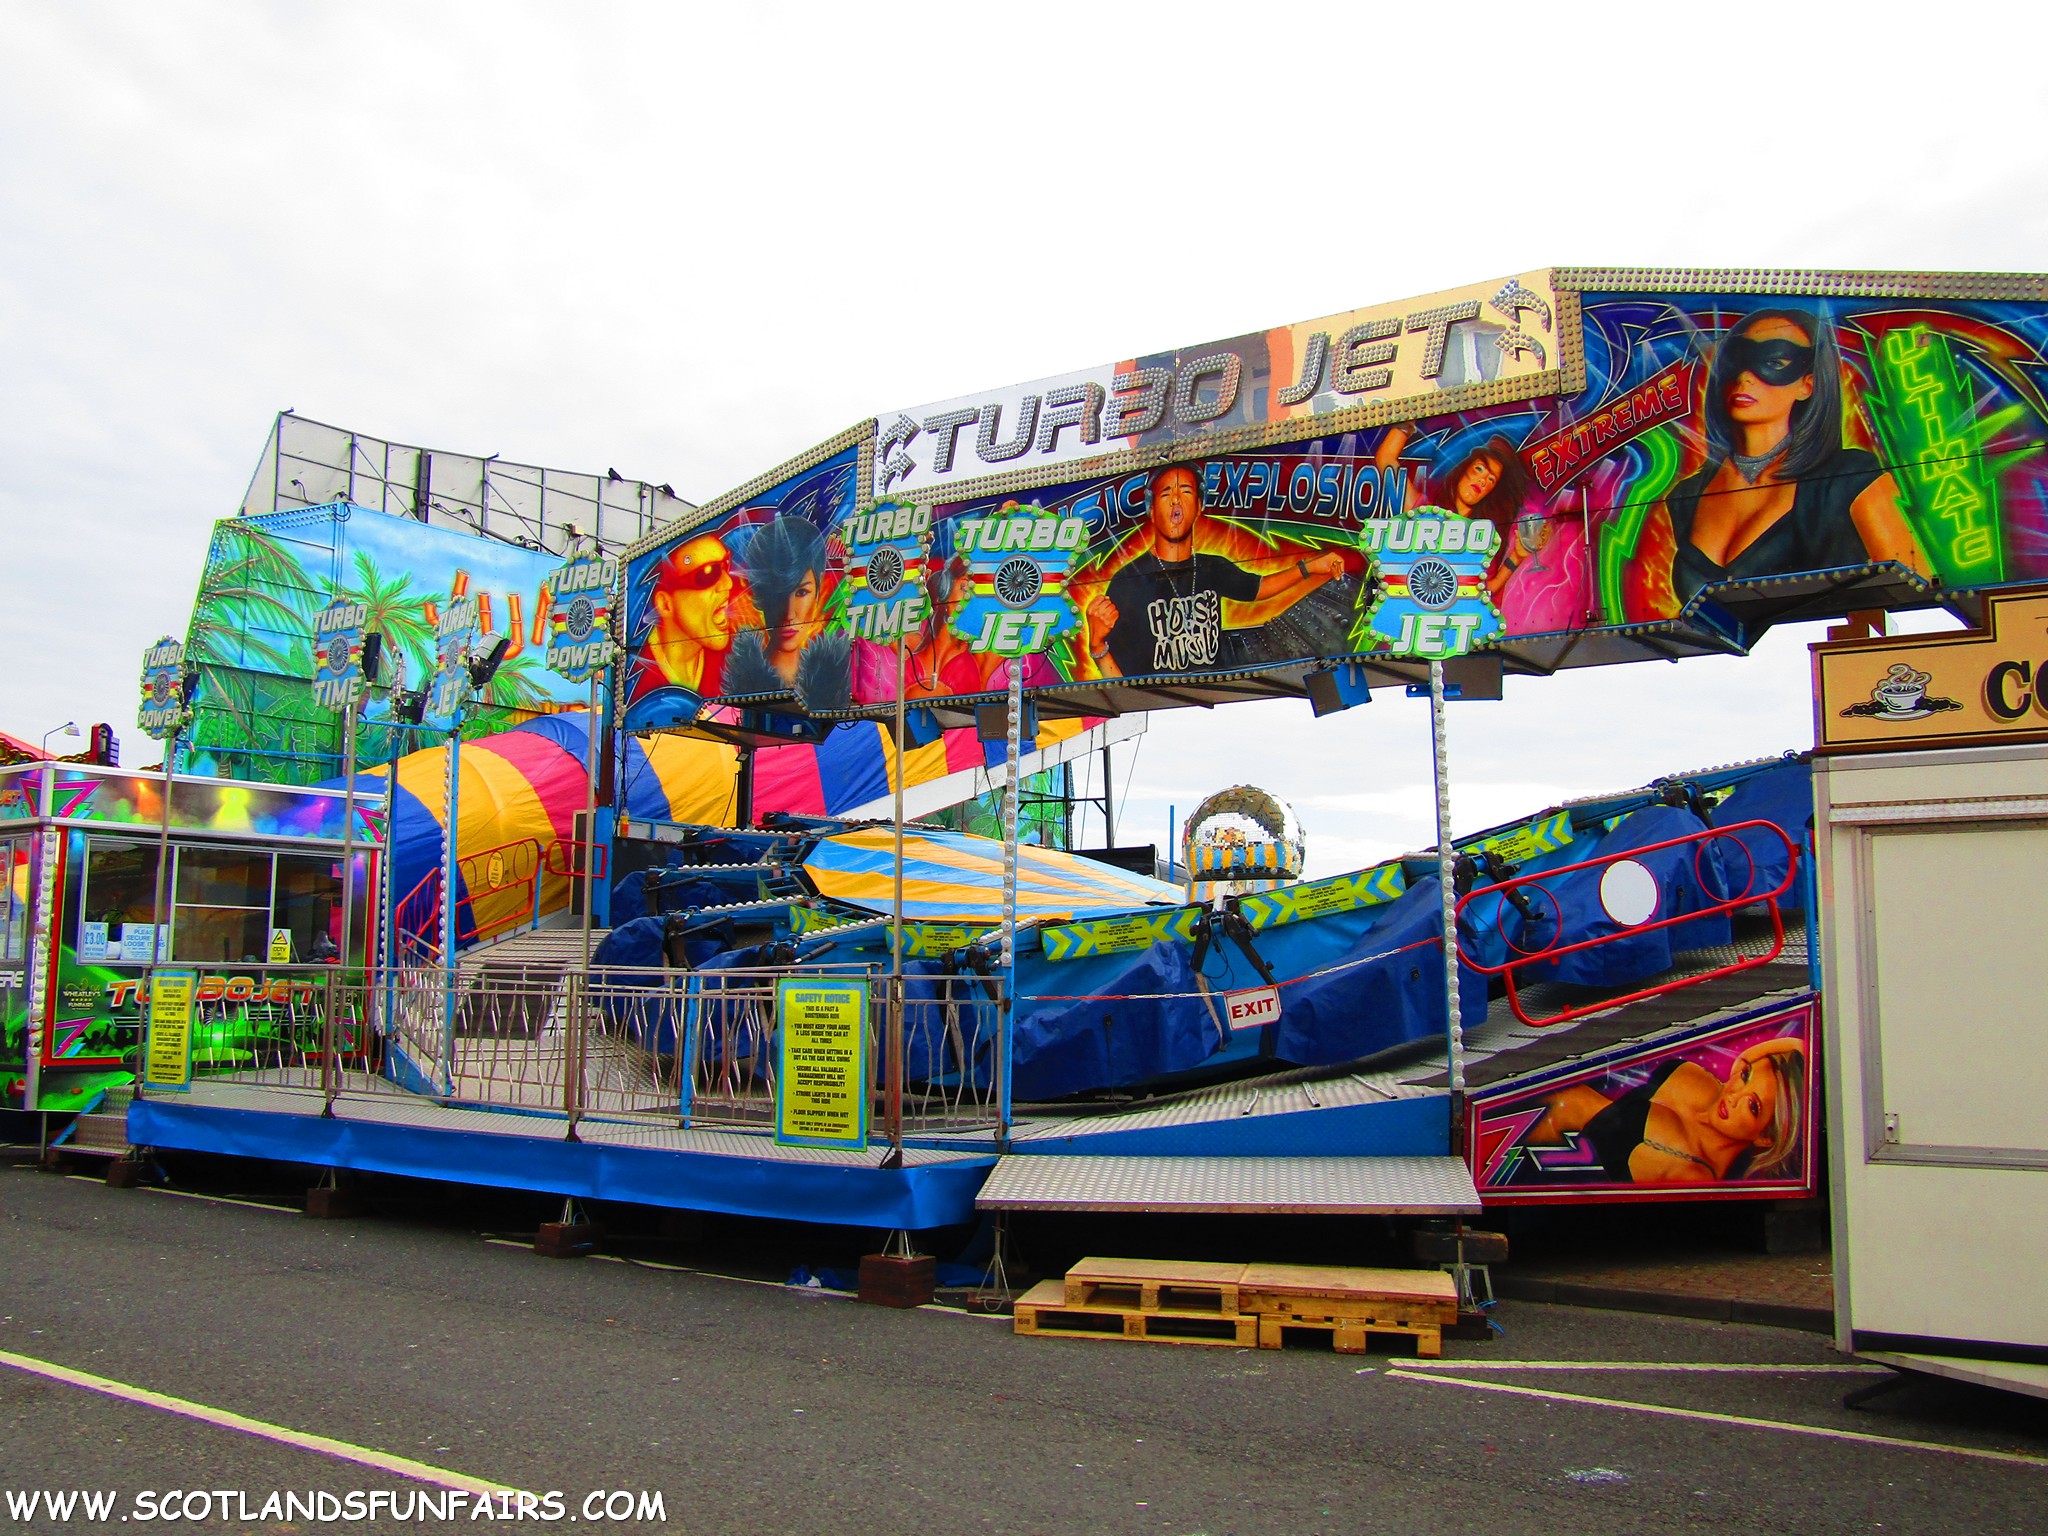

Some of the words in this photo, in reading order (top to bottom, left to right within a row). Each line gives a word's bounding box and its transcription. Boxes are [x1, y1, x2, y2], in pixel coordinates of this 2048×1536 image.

[922, 352, 1242, 473] TURBO
[1278, 299, 1482, 407] JET
[1532, 374, 1682, 490] EXTREME
[1886, 325, 1993, 567] ULTIMATE
[1057, 472, 1150, 538] SIC
[1202, 462, 1407, 521] EXPLOSION
[843, 504, 931, 544] TURBO
[962, 519, 1083, 550] TURBO
[1365, 520, 1494, 550] TURBO
[550, 560, 617, 593] TURBO
[313, 604, 367, 633] TURBO
[438, 600, 476, 637] TURBO
[847, 599, 925, 638] TIME
[1147, 590, 1219, 638] HOUSE
[971, 613, 1058, 652] JET
[1392, 615, 1479, 655] JET
[144, 644, 186, 667] TURBO
[546, 641, 616, 670] POWER
[314, 676, 364, 707] TIME
[435, 679, 463, 717] JET
[138, 709, 181, 728] POWER
[85, 932, 105, 945] £3.00
[0, 970, 24, 988] RE
[795, 993, 822, 1002] SAFETY
[825, 994, 850, 1003] NOTICE
[1231, 997, 1275, 1019] EXIT
